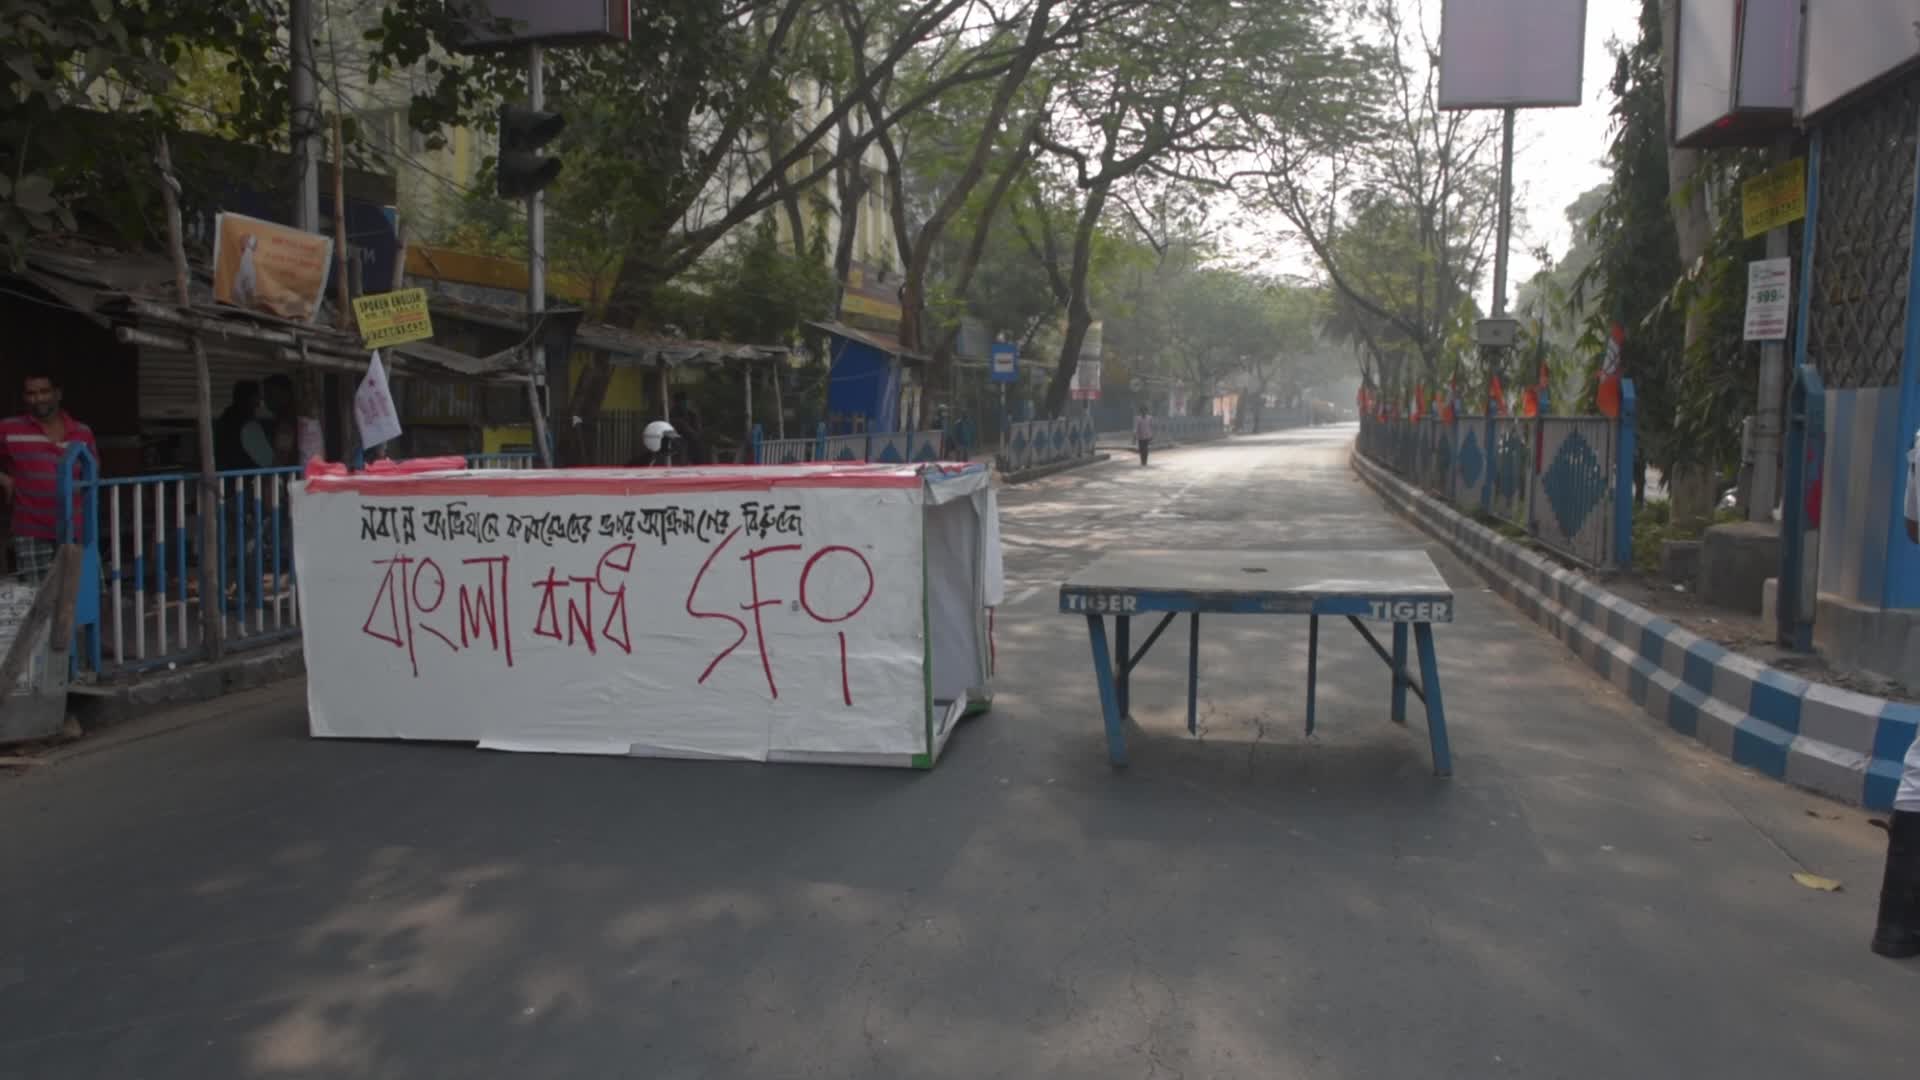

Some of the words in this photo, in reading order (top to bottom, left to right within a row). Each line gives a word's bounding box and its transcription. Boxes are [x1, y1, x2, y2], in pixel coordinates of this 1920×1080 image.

[360, 299, 390, 313] SPOKEN
[1066, 593, 1137, 612] TIGER
[1368, 601, 1449, 620] TIGER
[363, 553, 514, 677] বাংলা
